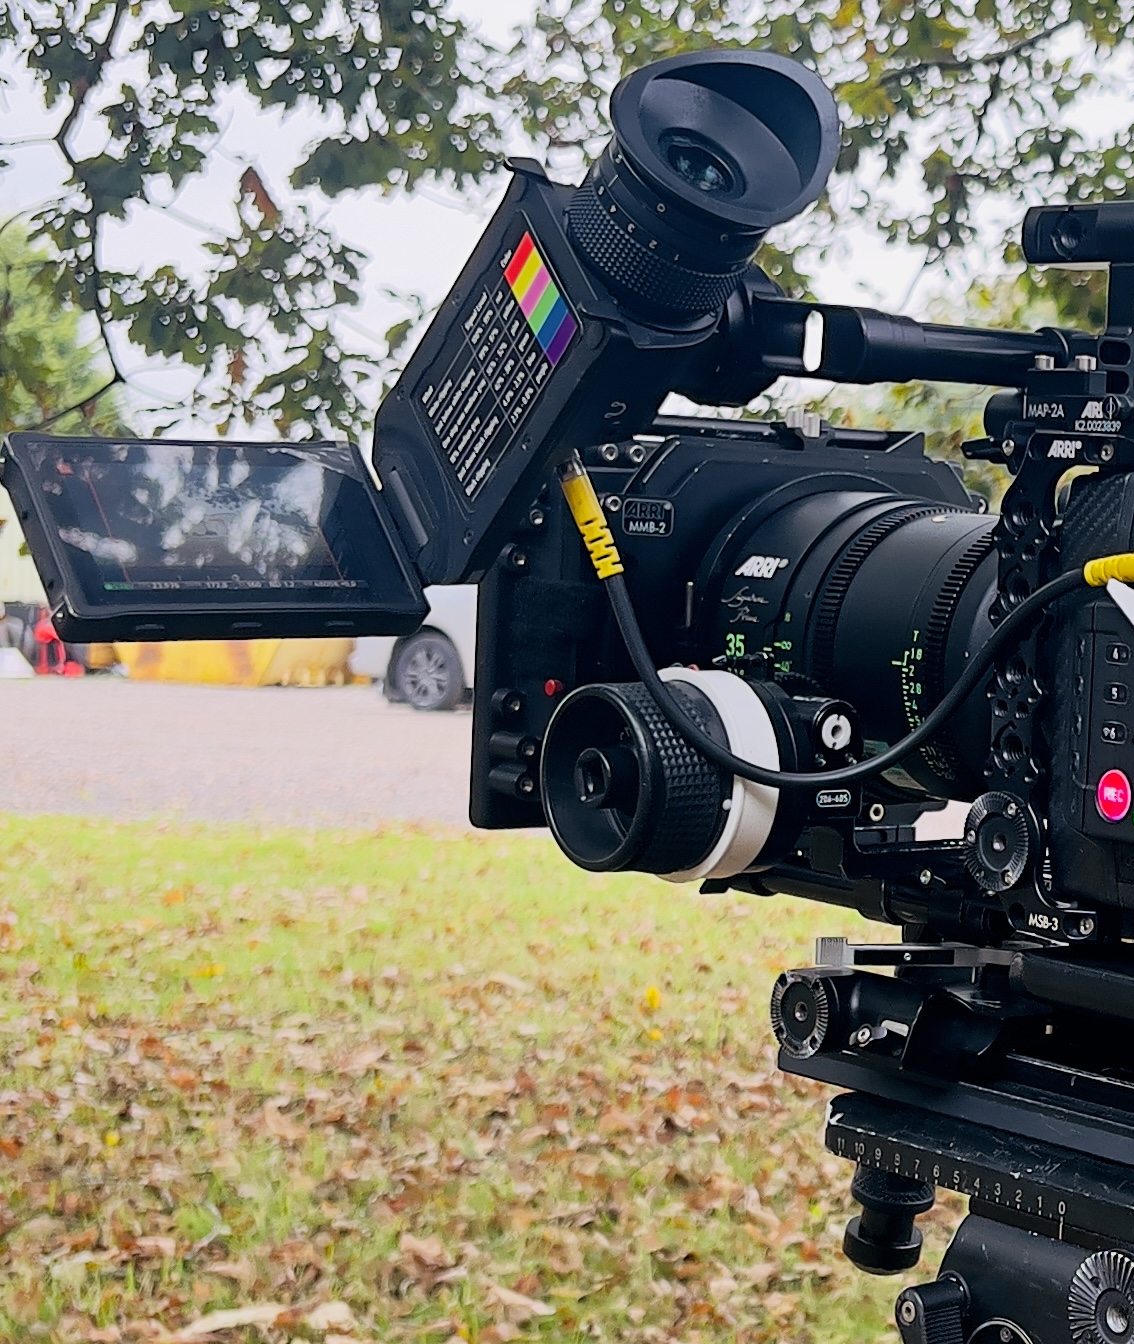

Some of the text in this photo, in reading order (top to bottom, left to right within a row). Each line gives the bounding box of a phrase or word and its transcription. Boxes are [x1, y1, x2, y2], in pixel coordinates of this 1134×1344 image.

[1028, 404, 1064, 418] MAP-2A
[1047, 440, 1076, 458] ARRI
[628, 521, 666, 533] MMB-2
[735, 555, 781, 578] ARRI
[726, 633, 745, 657] 35
[1103, 787, 1125, 804] REC
[1028, 912, 1059, 931] MSB-3
[854, 1142, 865, 1155] 10
[875, 1147, 882, 1160] 9
[914, 1159, 921, 1172] 7
[933, 1165, 940, 1178] 6
[953, 1171, 960, 1184] 5
[973, 1177, 981, 1189] 4
[994, 1183, 1001, 1196] 3
[1015, 1189, 1023, 1202] 2
[1037, 1196, 1043, 1209] 1
[1058, 1201, 1066, 1215] 0
